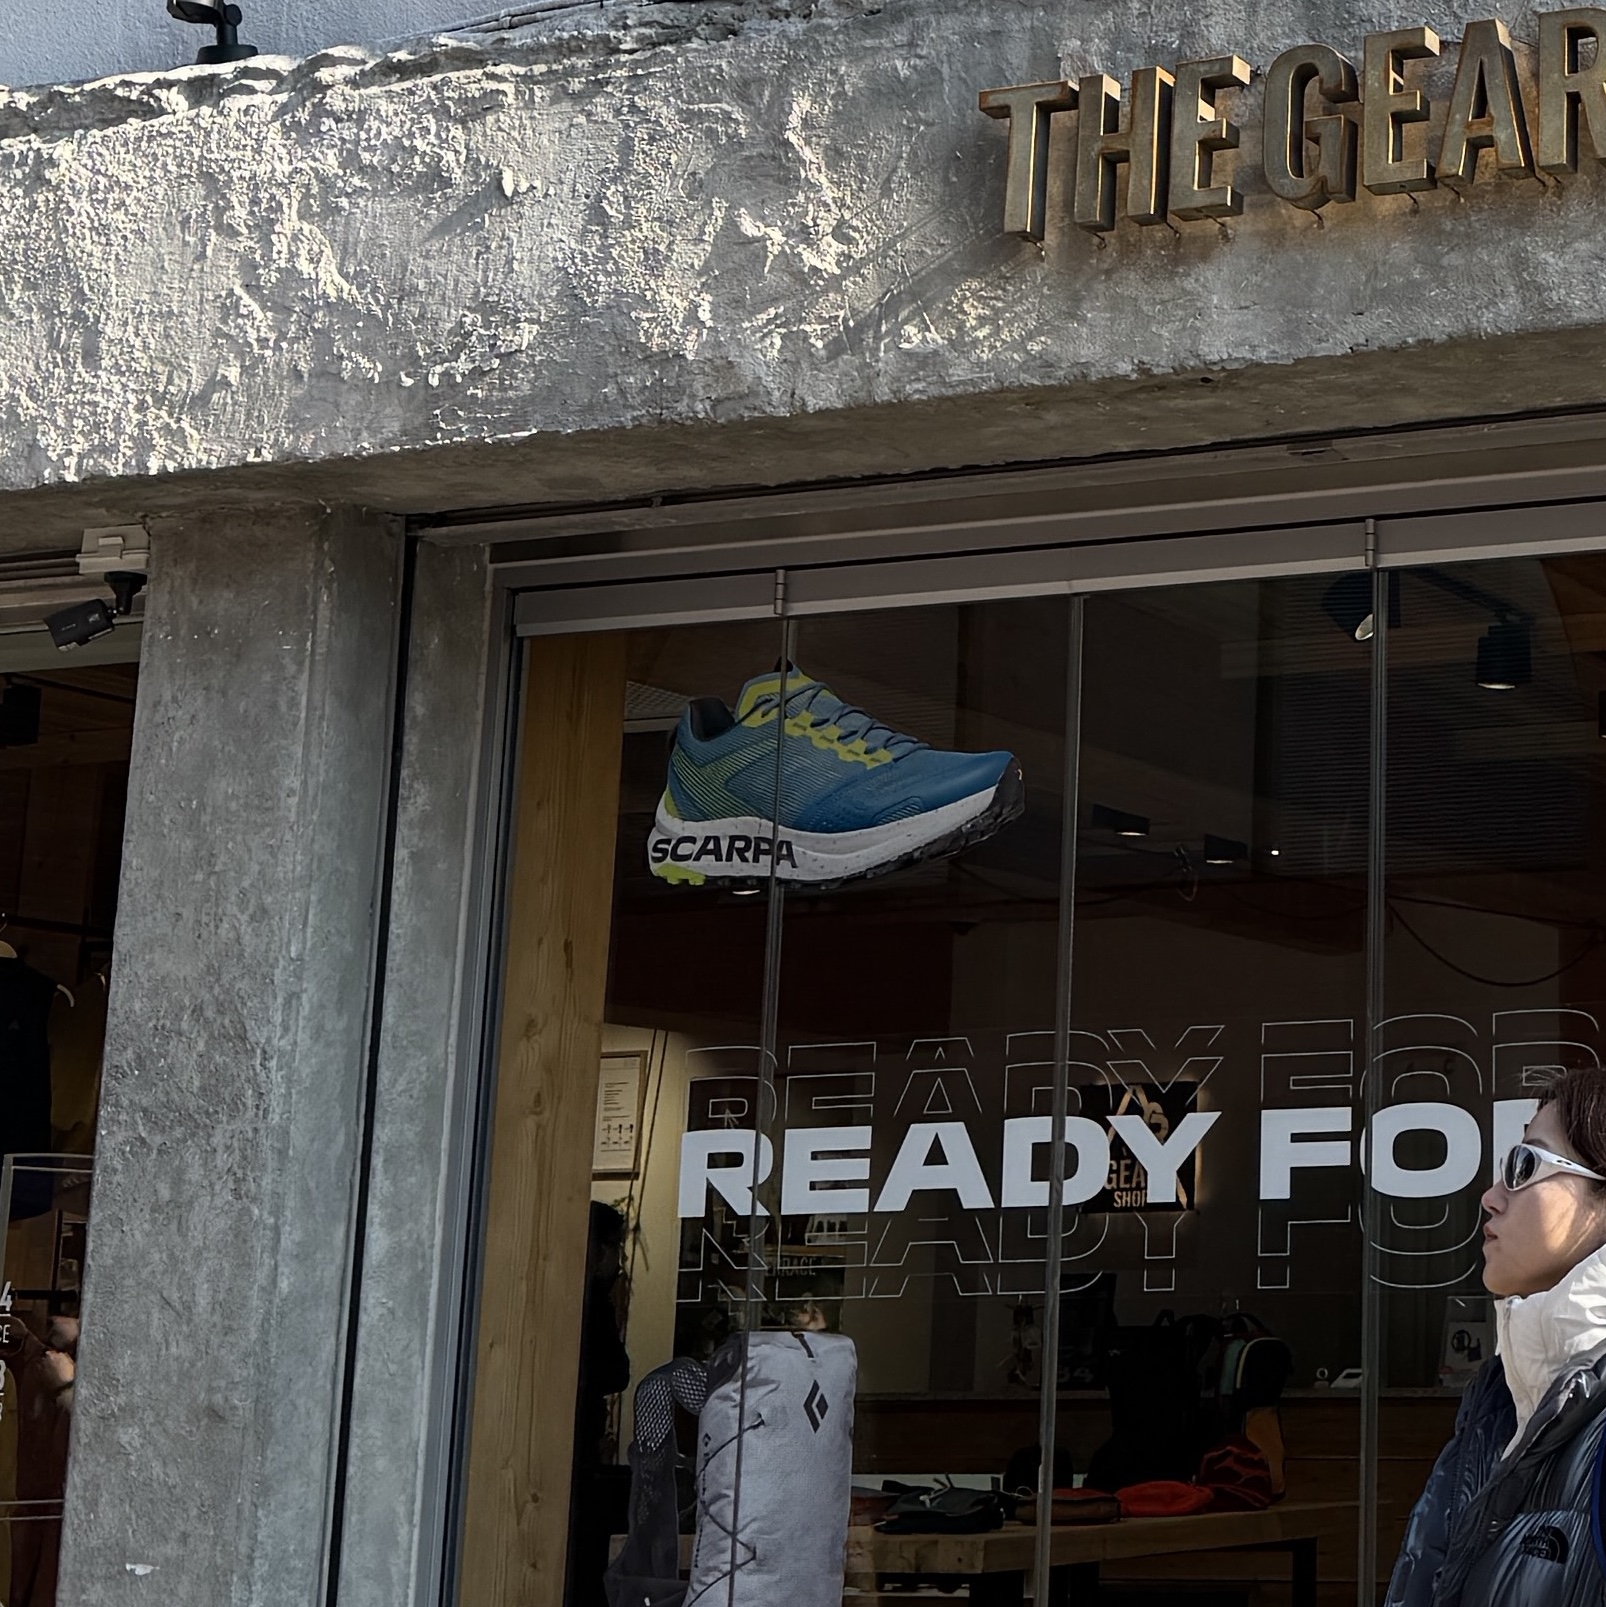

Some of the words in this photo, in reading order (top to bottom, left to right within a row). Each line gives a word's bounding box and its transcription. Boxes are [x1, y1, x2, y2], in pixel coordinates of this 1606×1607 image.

[979, 54, 1251, 243] THE
[651, 834, 798, 868] SCARPA
[678, 1110, 1223, 1218] READY
[1104, 1159, 1146, 1189] GEA
